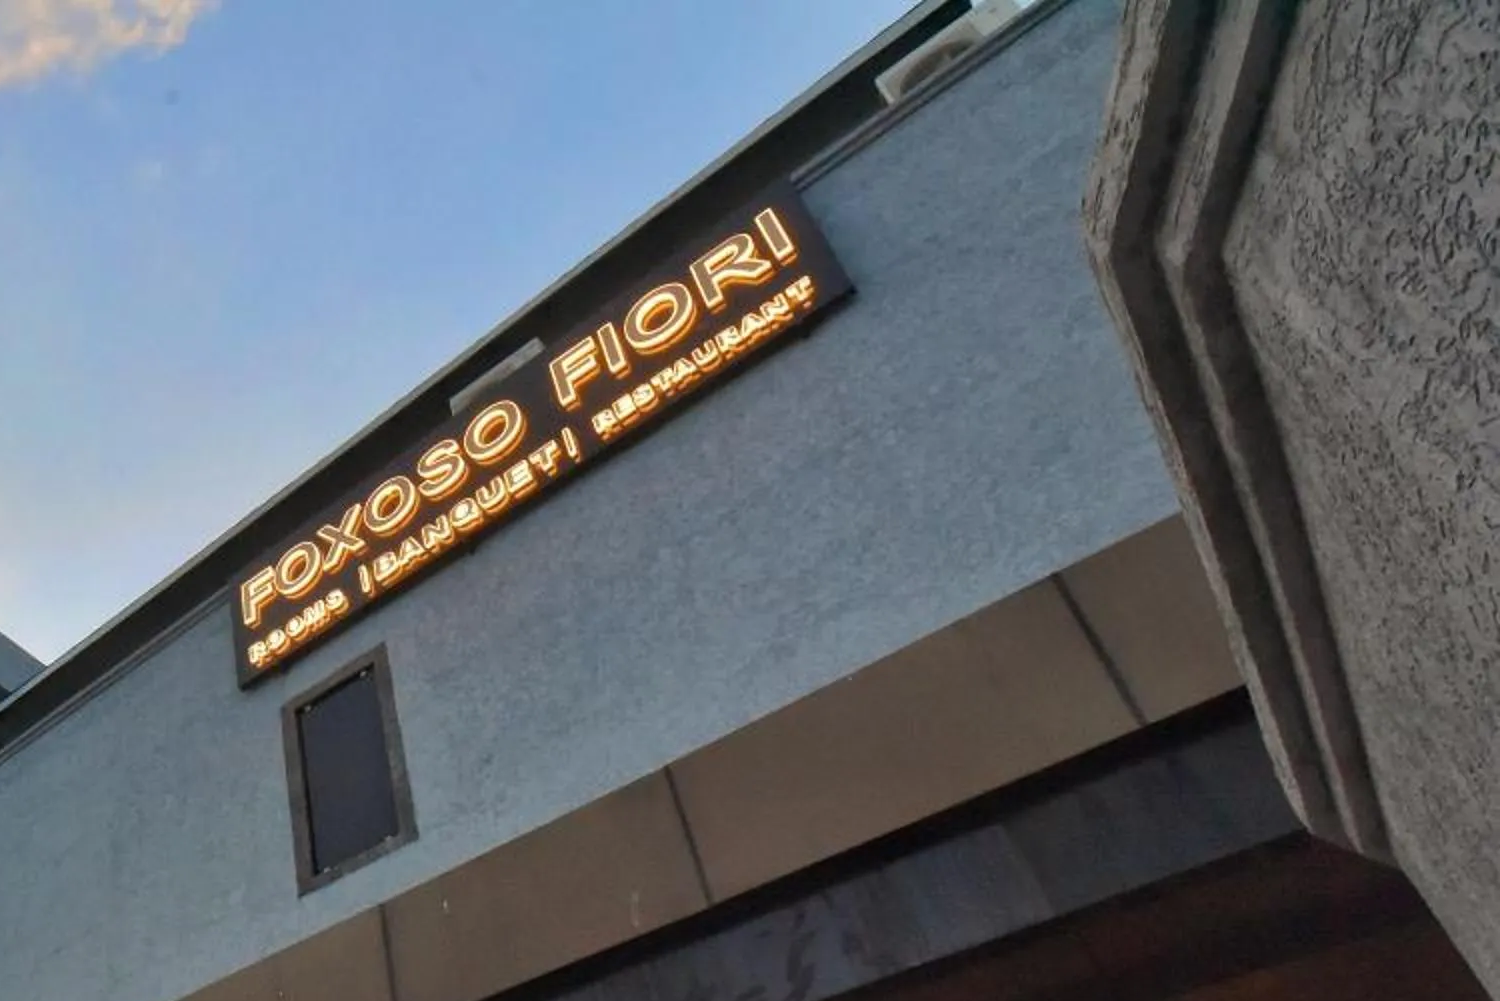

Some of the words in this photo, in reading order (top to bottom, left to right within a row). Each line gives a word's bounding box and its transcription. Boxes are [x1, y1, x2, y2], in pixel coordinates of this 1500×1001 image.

[240, 400, 526, 627] FOXOSO
[548, 207, 798, 411] FIORI
[248, 588, 349, 668] ROOMS
[591, 274, 817, 440] RESTAURANT
